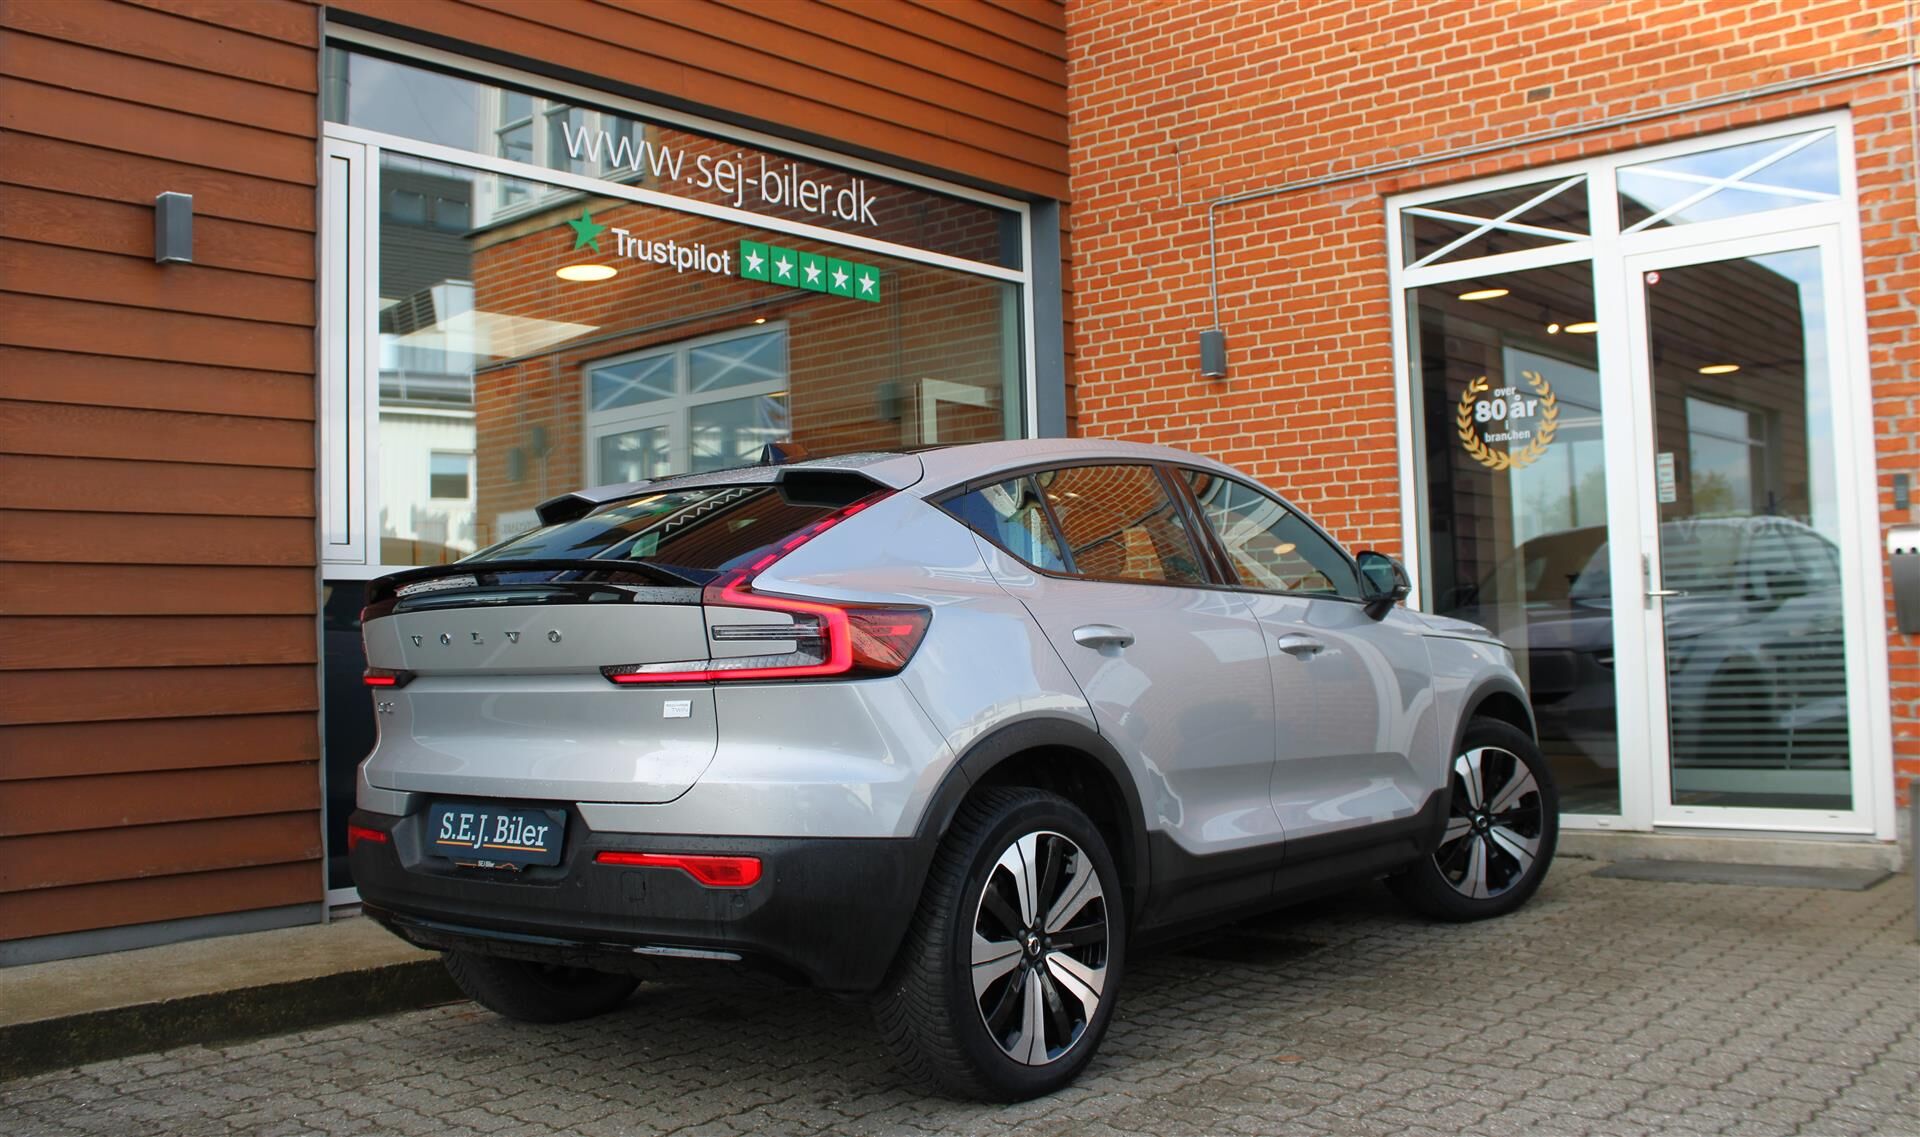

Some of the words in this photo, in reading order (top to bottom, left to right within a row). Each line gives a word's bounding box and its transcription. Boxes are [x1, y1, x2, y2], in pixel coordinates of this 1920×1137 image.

[562, 121, 878, 226] www.sej-biler.dk
[611, 227, 731, 275] Trustpilot
[1494, 386, 1517, 397] over
[1475, 398, 1507, 422] 80
[1510, 395, 1538, 418] år
[1505, 420, 1509, 430] i
[1485, 431, 1530, 442] branchen
[411, 630, 562, 647] VOLVO
[440, 812, 488, 849] S.E.J.
[493, 816, 548, 846] Biler
